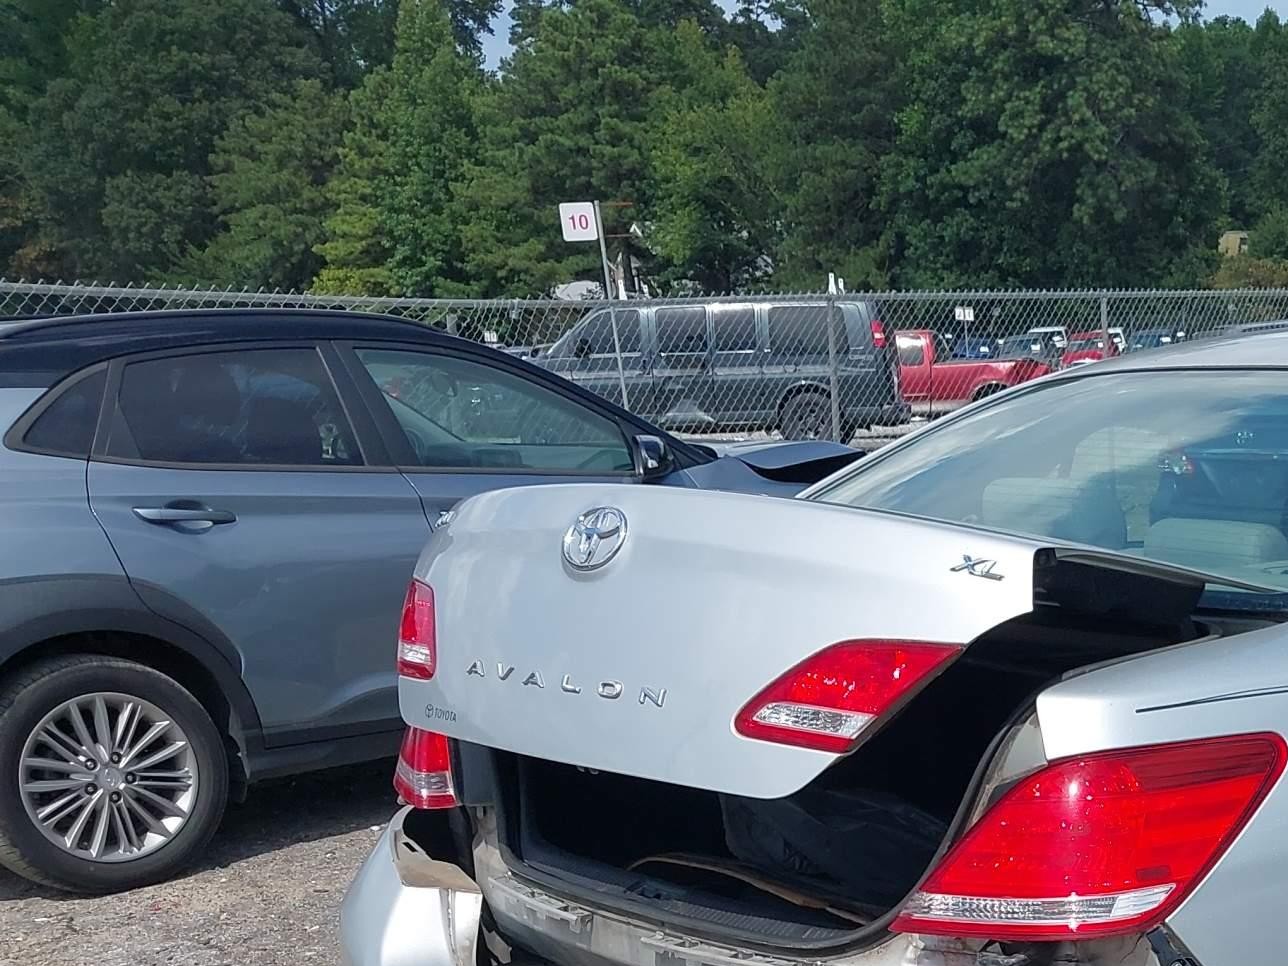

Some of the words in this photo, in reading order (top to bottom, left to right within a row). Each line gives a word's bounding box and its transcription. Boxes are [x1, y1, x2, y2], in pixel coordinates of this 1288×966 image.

[568, 214, 589, 230] 10
[466, 659, 667, 708] AVALON
[434, 707, 457, 723] TOYOTA
